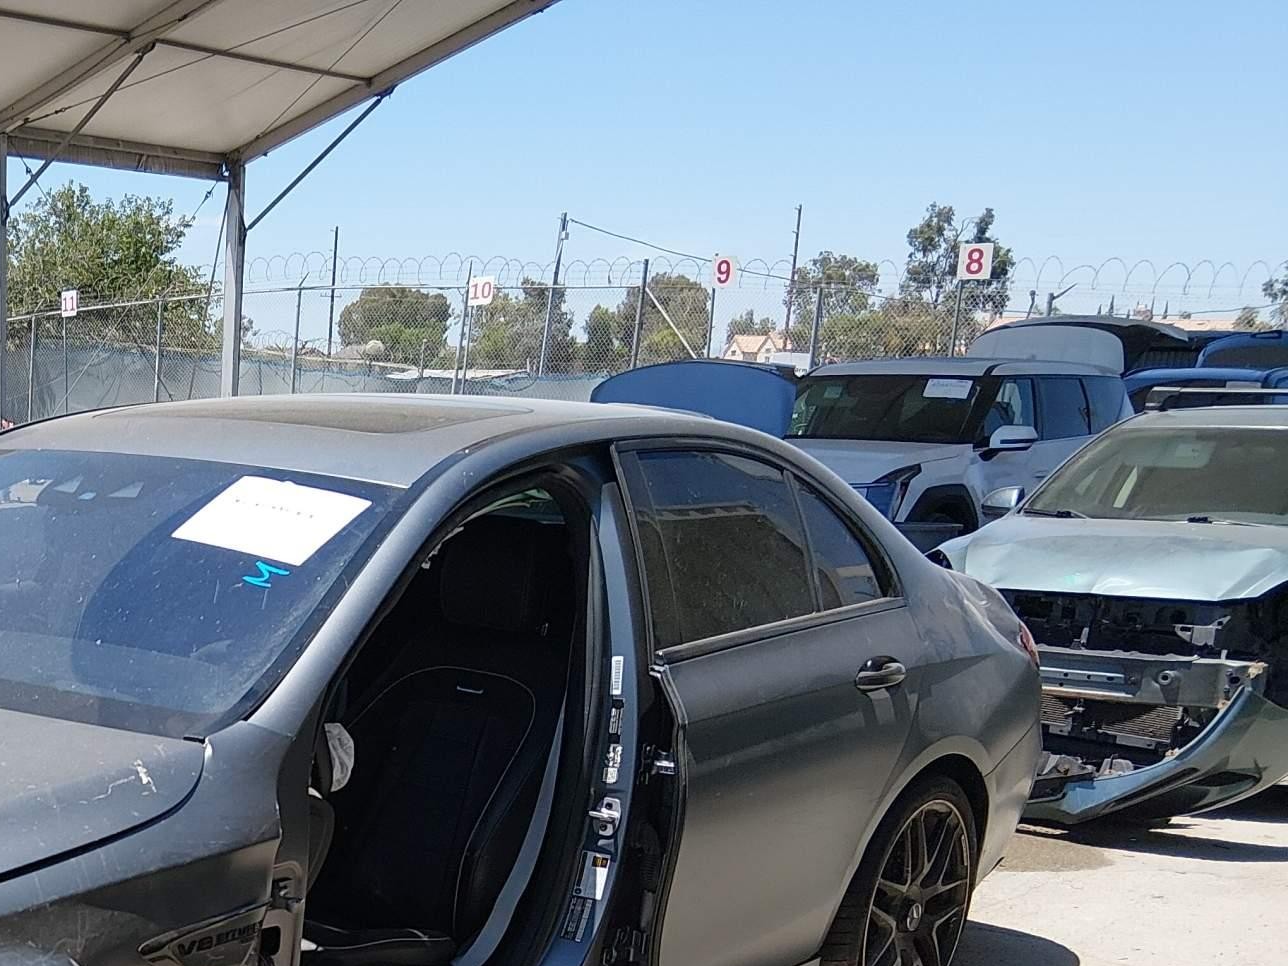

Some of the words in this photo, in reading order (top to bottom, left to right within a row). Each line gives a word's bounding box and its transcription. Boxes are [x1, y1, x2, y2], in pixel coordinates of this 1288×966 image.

[717, 259, 731, 284] 9
[965, 248, 984, 275] 8
[470, 281, 492, 300] 10
[63, 295, 76, 312] 11
[178, 936, 214, 956] V8
